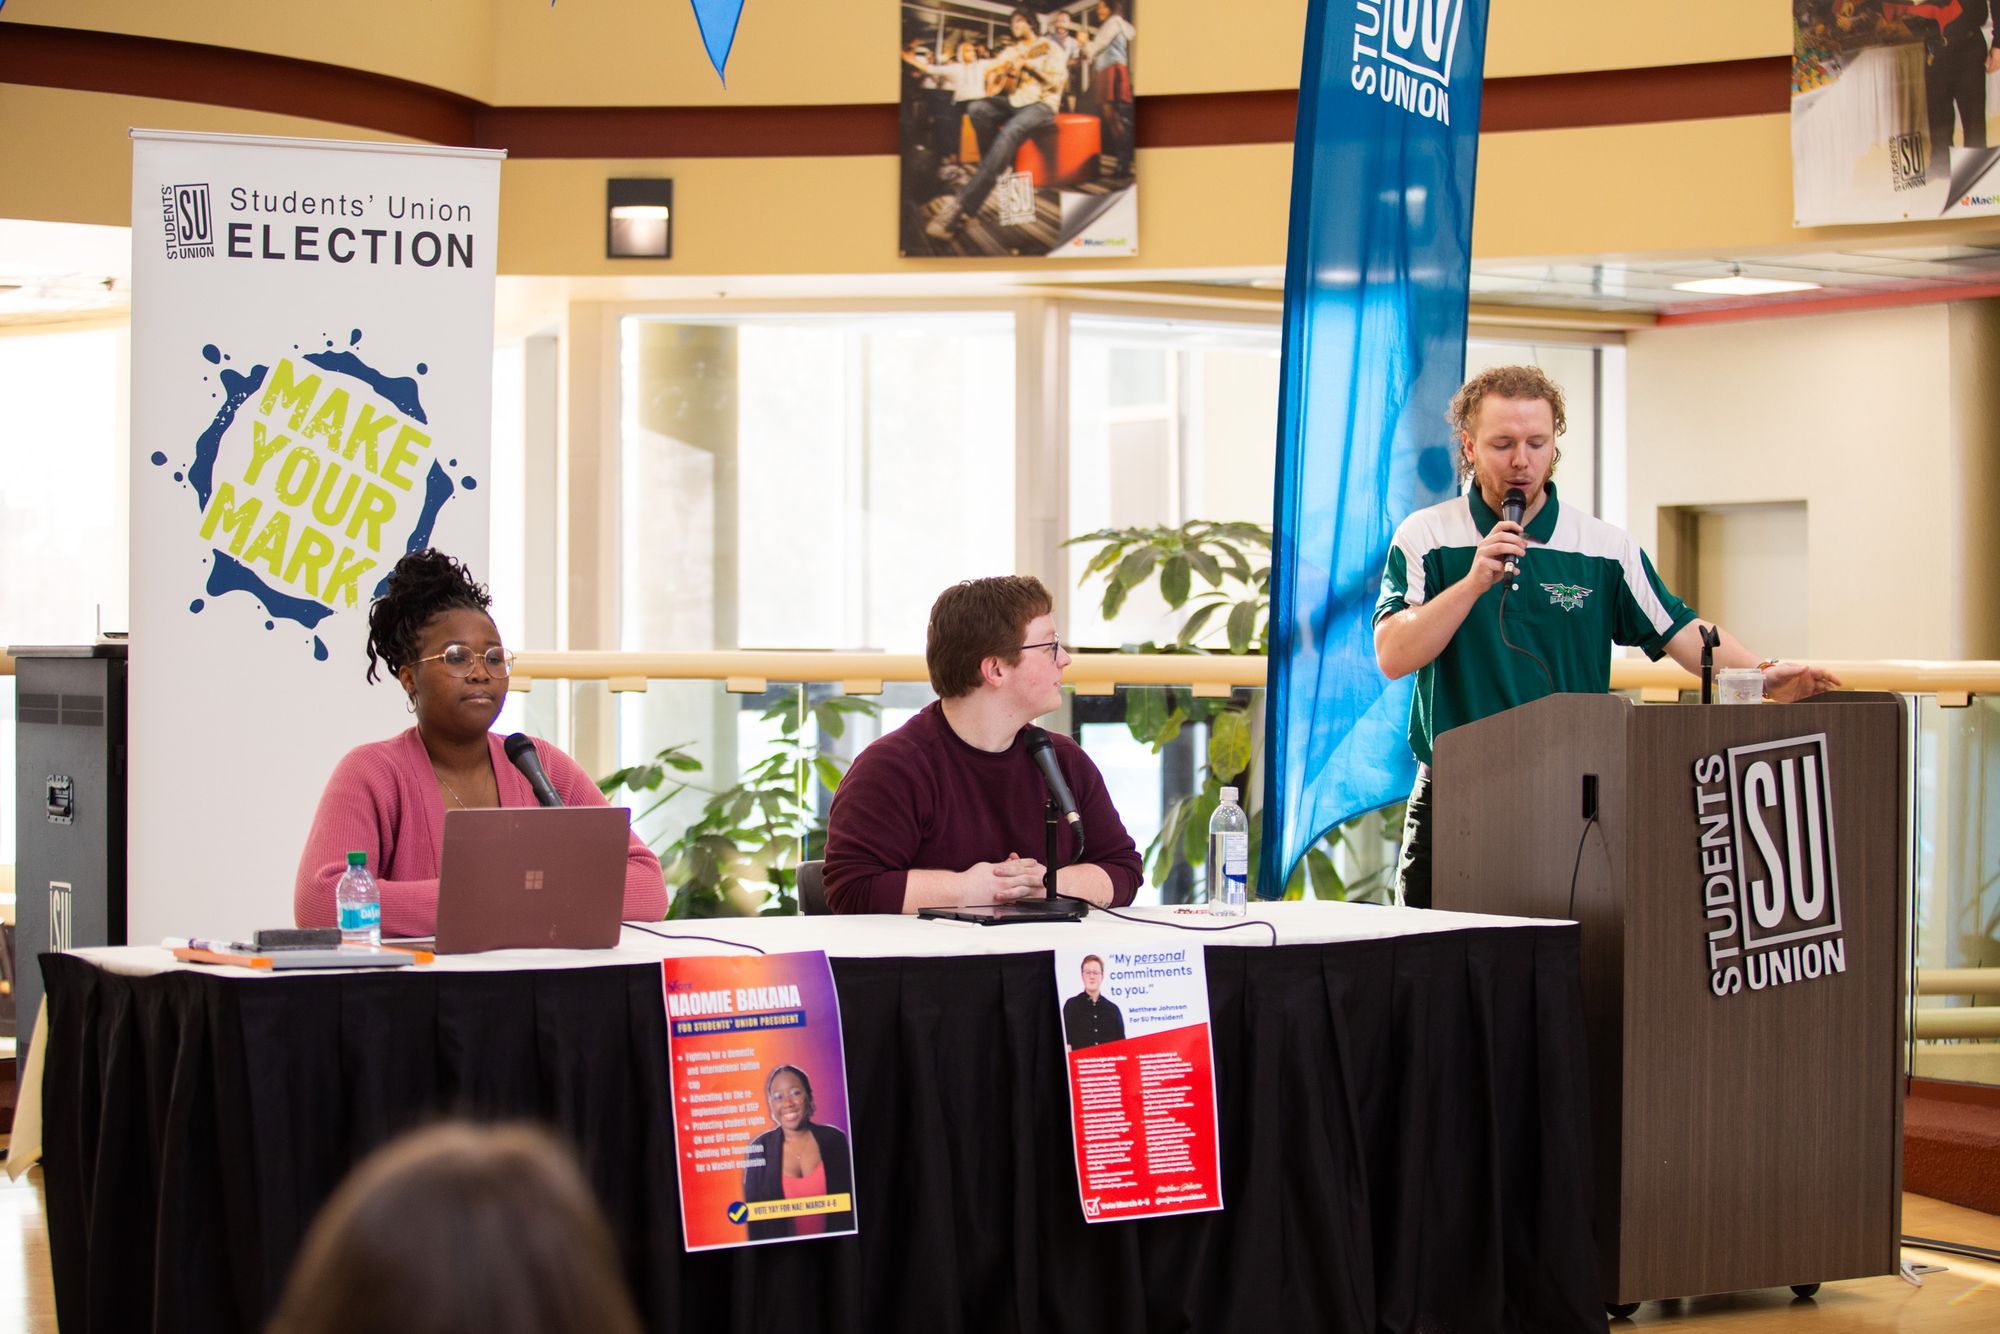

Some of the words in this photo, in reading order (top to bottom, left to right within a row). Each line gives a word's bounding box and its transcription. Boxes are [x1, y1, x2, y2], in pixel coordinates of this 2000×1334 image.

[1351, 0, 1381, 95] STU
[1380, 64, 1450, 127] UNION
[1901, 136, 1920, 176] SU
[161, 184, 178, 260] STUDENTS'
[180, 189, 208, 241] SU
[230, 187, 374, 217] Students’
[388, 195, 472, 222] Union
[180, 246, 215, 259] UNION
[228, 222, 474, 269] ELECTION
[258, 357, 432, 492] MAKE
[242, 419, 397, 552] YOUR
[200, 481, 378, 610] MARK
[1744, 755, 1825, 929] SU
[1695, 753, 1742, 997] STUDENTS
[1110, 966, 1193, 980] commitments
[1134, 949, 1186, 966] personal
[1746, 938, 1847, 991] UNION
[668, 989, 733, 1017] NAOMIE
[736, 984, 802, 1012] BAKANA
[1111, 986, 1122, 996] to
[677, 1022, 692, 1034] FOR
[735, 1017, 759, 1028] UNION
[760, 1014, 799, 1027] PRESIDENT
[754, 1206, 768, 1215] VOTE
[780, 1204, 792, 1212] FOR
[805, 1201, 825, 1210] MARCH
